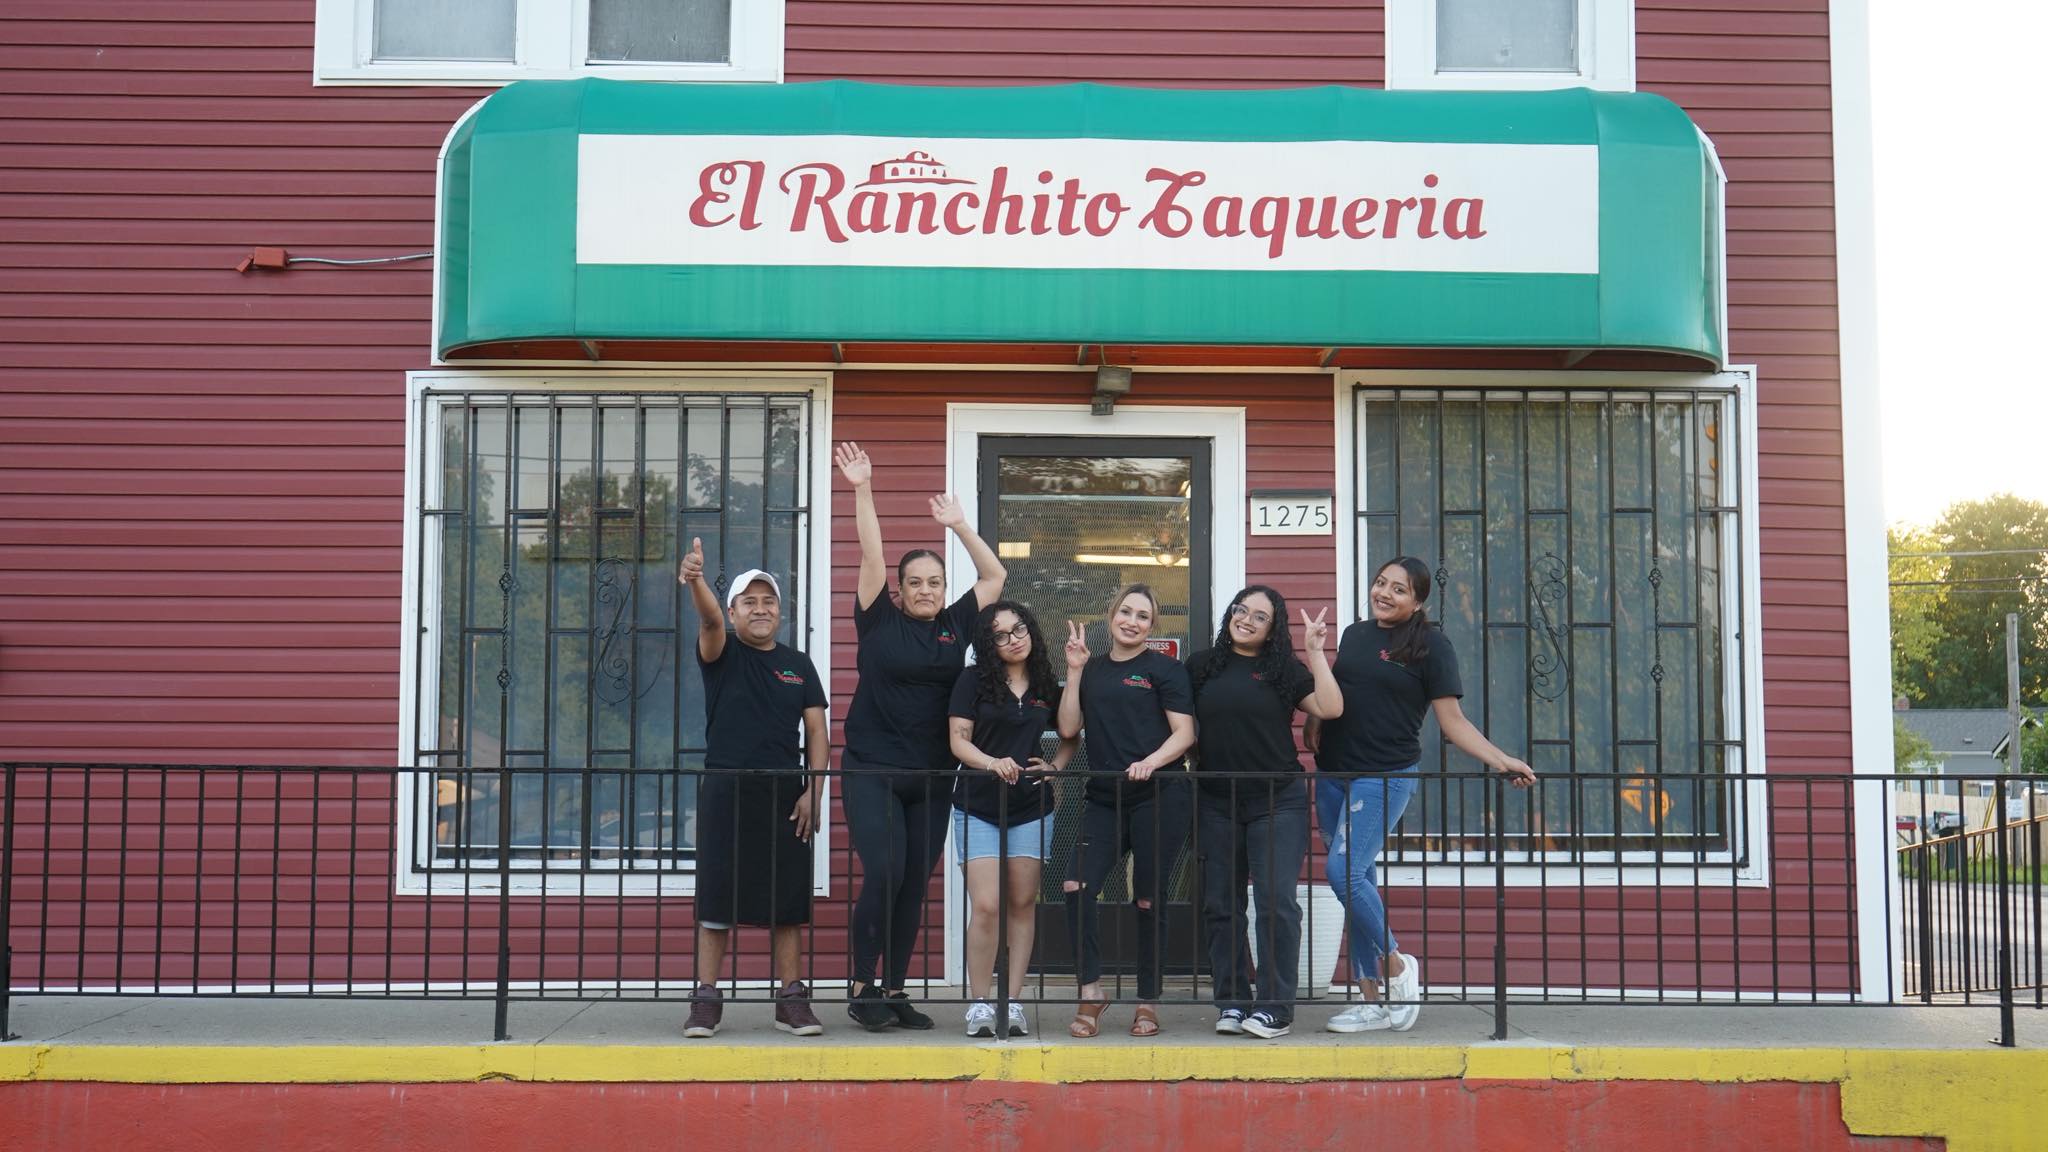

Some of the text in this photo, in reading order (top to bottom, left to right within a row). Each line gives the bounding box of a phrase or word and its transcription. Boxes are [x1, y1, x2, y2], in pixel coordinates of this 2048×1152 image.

[689, 161, 1488, 259] El Ranchito Taqueria
[1259, 505, 1329, 527] 1275
[1144, 641, 1170, 650] SINESS
